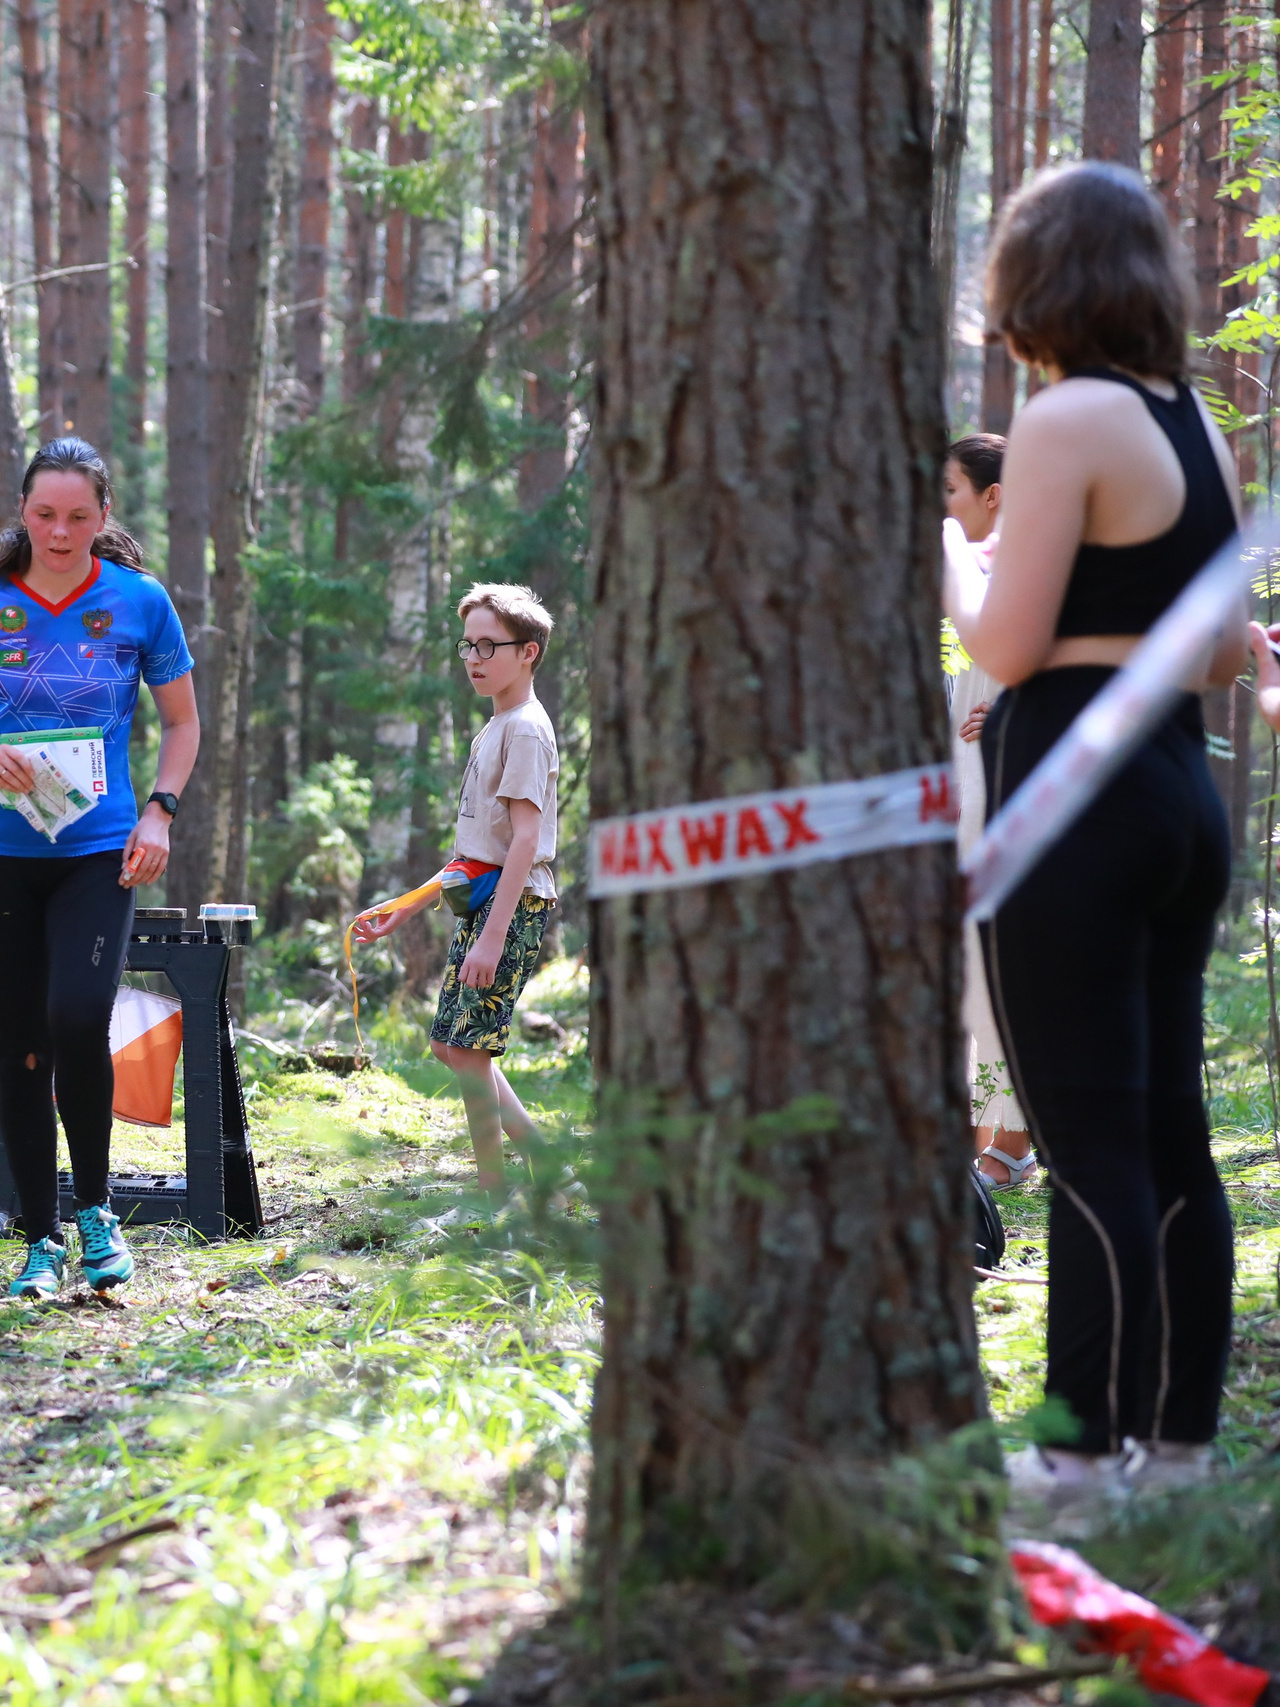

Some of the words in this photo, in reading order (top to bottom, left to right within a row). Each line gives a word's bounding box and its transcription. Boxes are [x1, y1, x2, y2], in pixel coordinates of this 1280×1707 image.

[3, 652, 22, 661] SFR
[88, 742, 97, 778] ПЕРМСКИЙ
[96, 750, 104, 778] ПЕРИОД
[680, 799, 820, 868] WAX
